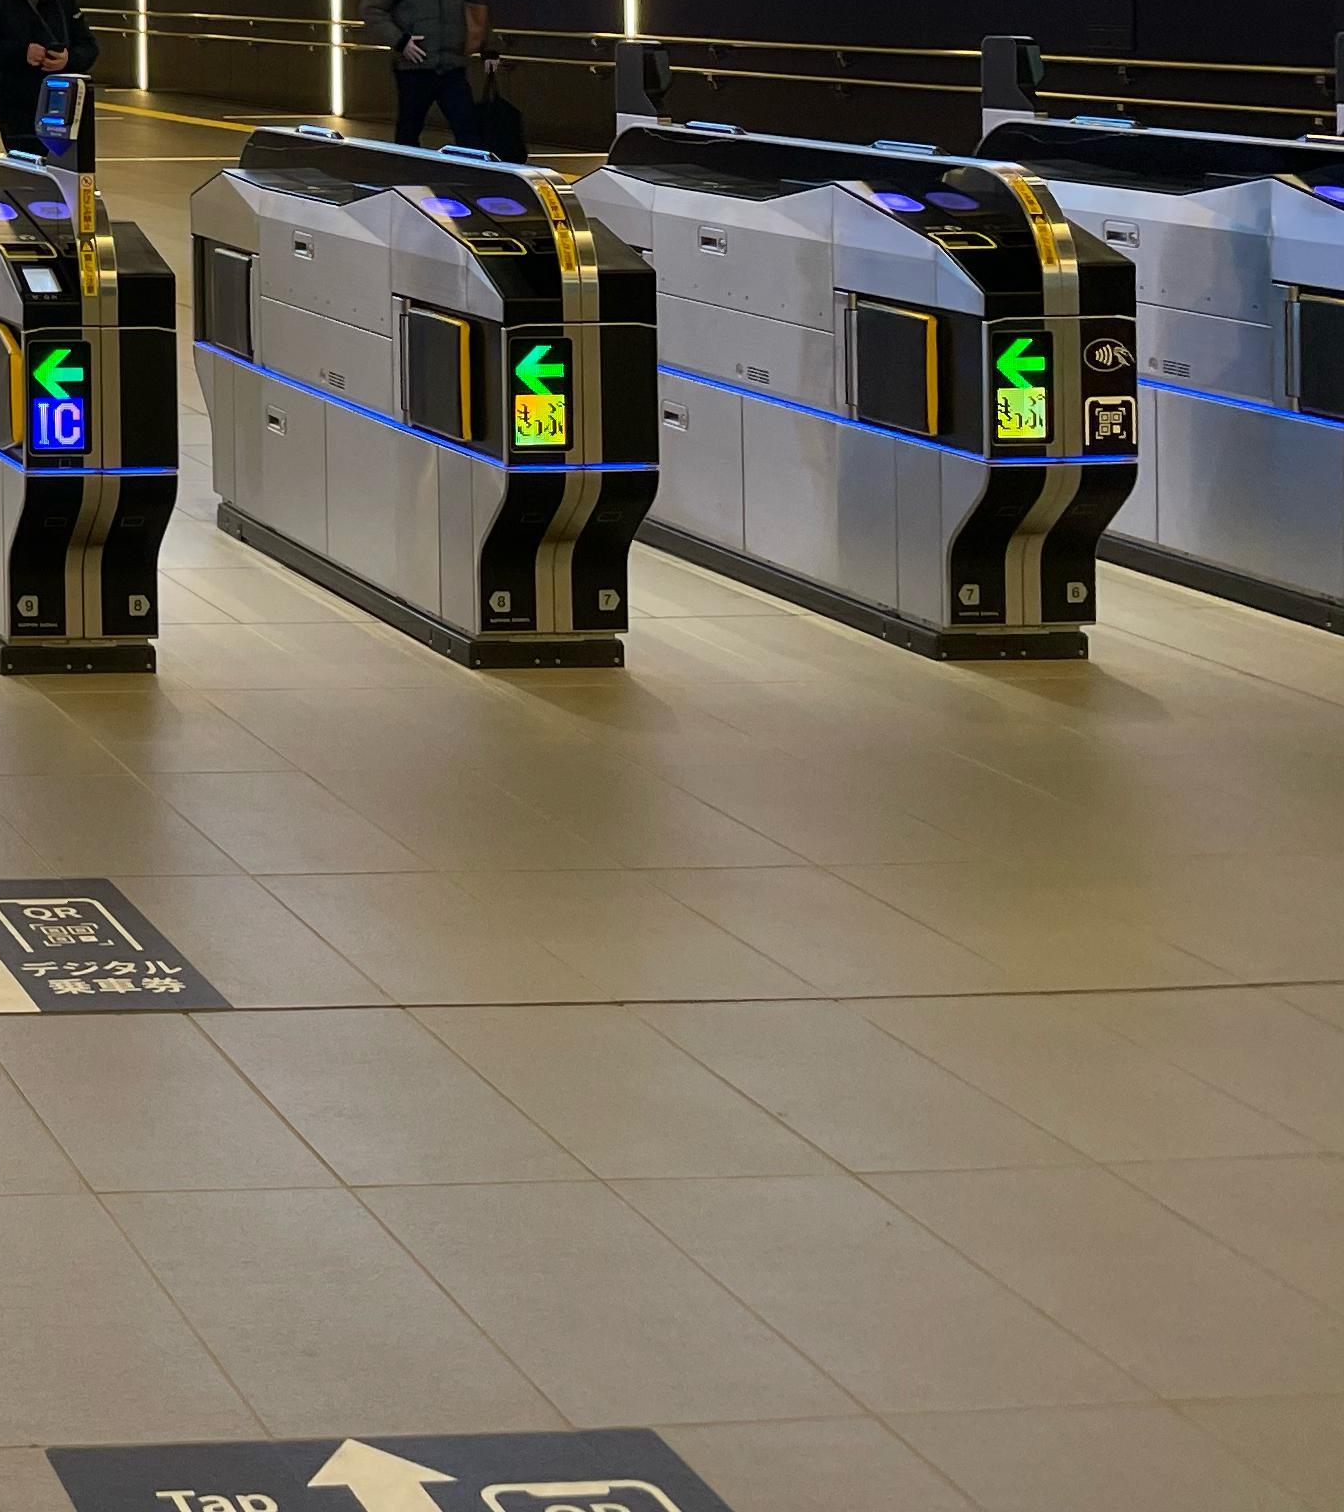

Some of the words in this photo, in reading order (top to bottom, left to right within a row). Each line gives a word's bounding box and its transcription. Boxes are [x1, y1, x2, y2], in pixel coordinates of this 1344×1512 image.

[38, 403, 80, 445] IC
[966, 589, 974, 601] 7
[1072, 587, 1080, 599] 6
[25, 600, 34, 612] 9
[134, 600, 143, 612] 8
[497, 596, 506, 608] 8
[604, 594, 612, 606] 7
[23, 906, 85, 921] QR
[20, 960, 183, 977] デジタル
[47, 977, 187, 996] 乗車券
